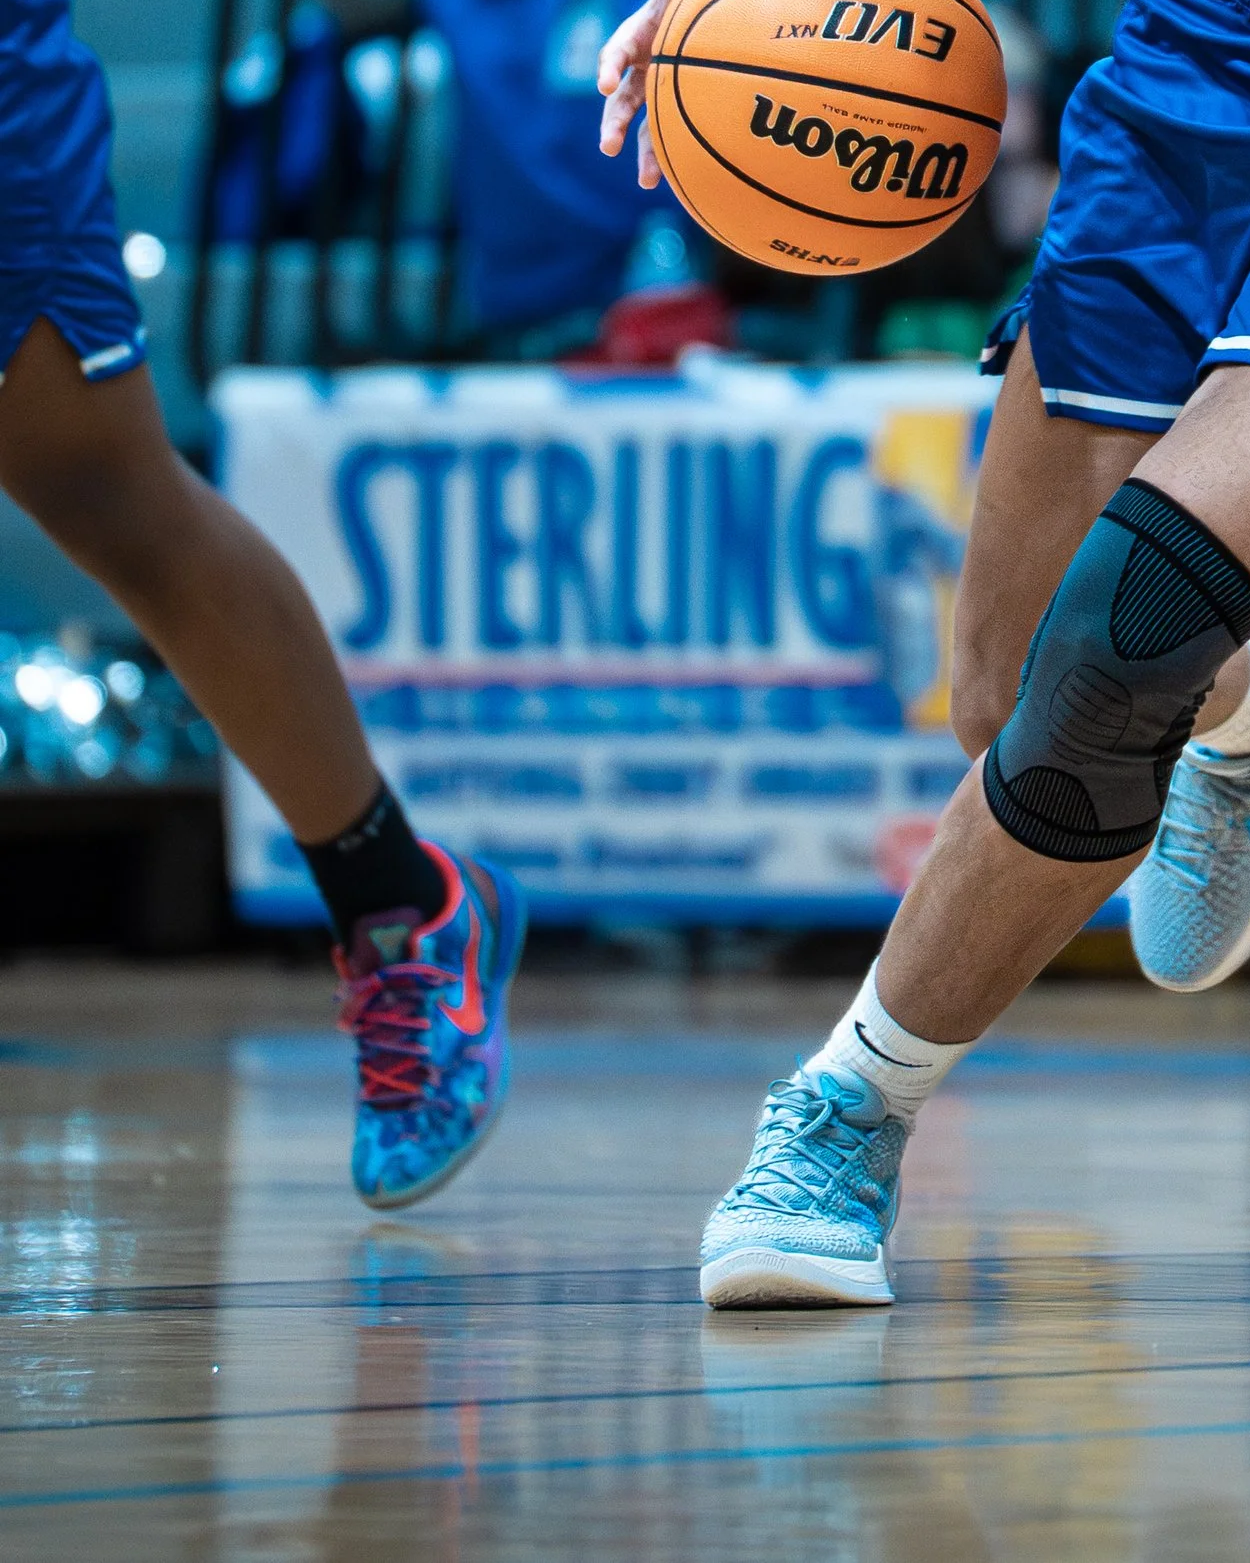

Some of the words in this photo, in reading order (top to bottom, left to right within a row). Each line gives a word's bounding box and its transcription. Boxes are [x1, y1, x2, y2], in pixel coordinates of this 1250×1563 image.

[772, 23, 820, 40] NXT
[749, 93, 969, 199] Wilson
[769, 239, 843, 267] NFHS
[331, 438, 880, 651] STERLING
